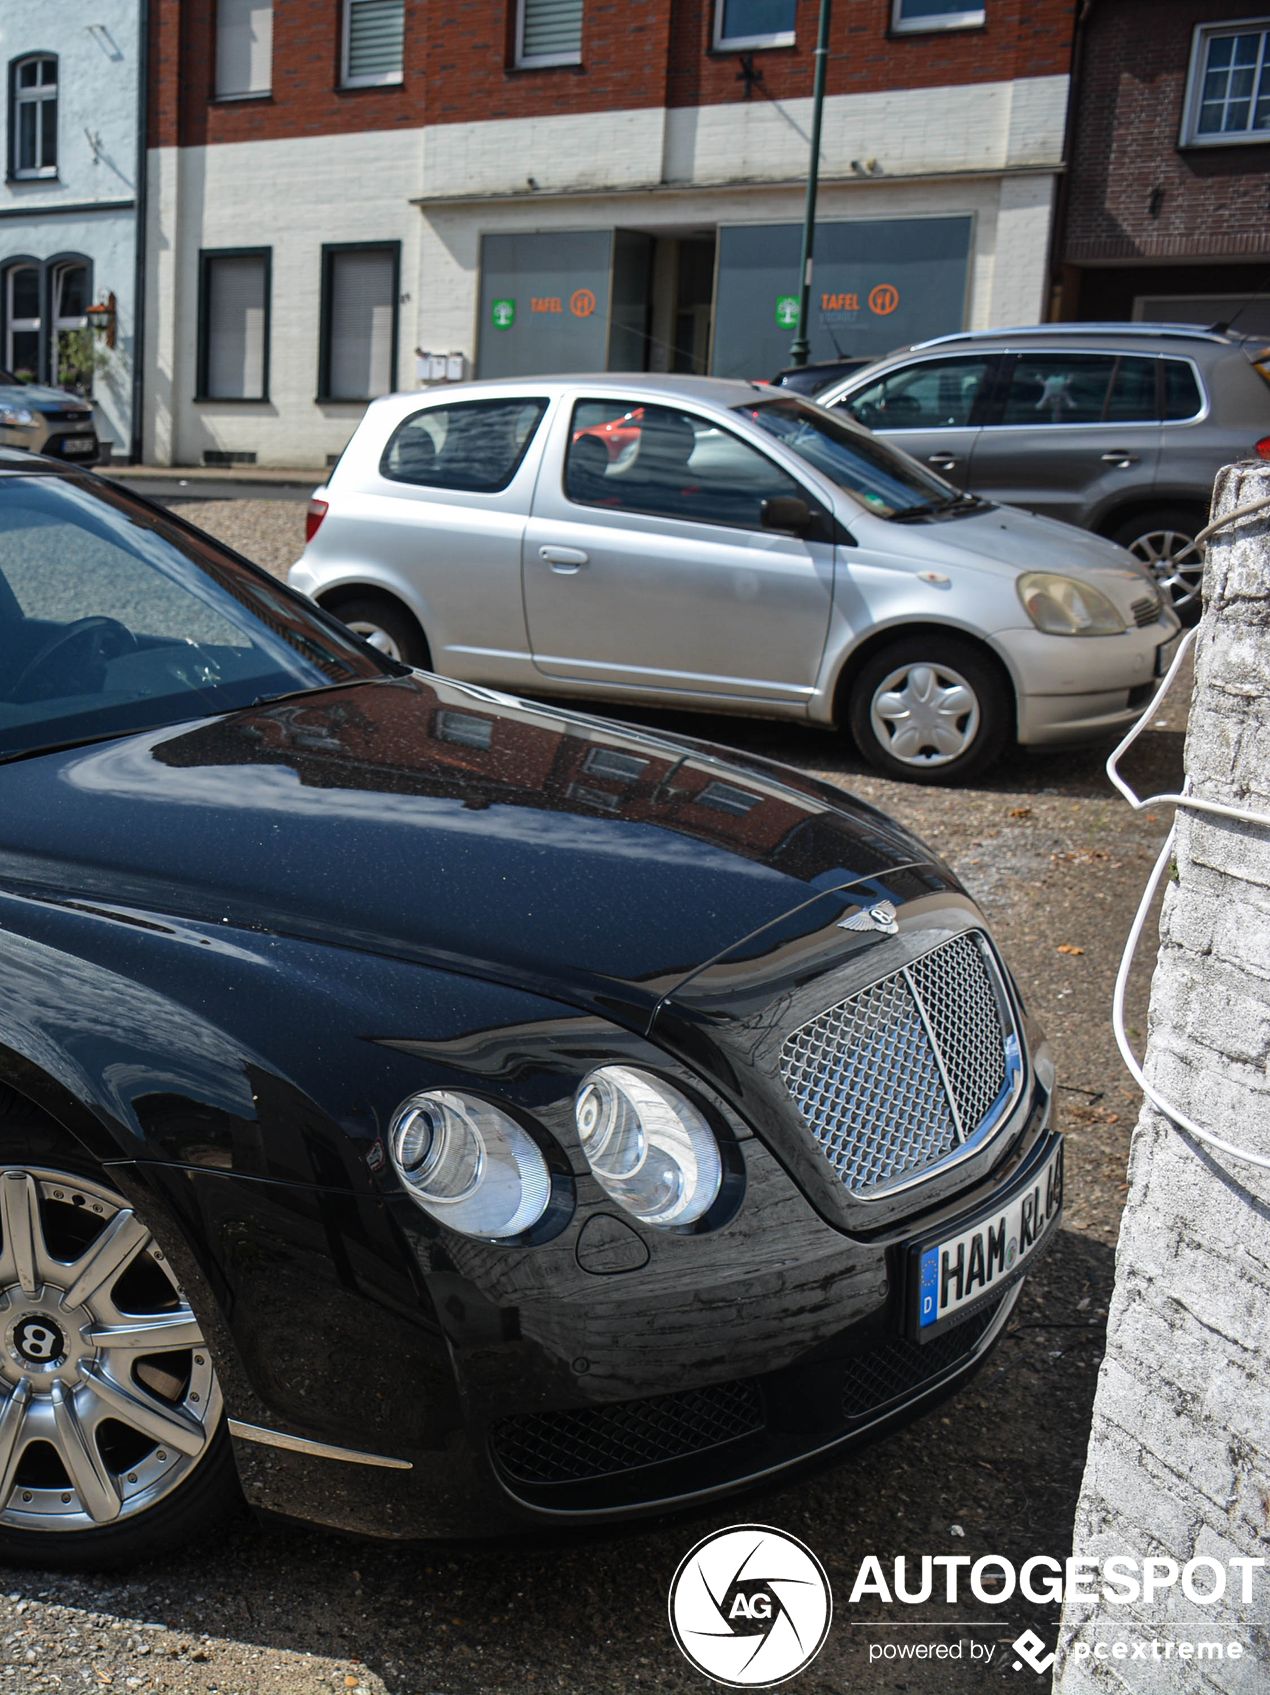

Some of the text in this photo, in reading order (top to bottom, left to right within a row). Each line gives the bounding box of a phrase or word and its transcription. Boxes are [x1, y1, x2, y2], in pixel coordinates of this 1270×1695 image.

[531, 298, 563, 313] TAFEL
[821, 294, 860, 310] TAFEL
[940, 1217, 1006, 1309] HAM
[1019, 1186, 1045, 1255] RL
[923, 1296, 932, 1315] D
